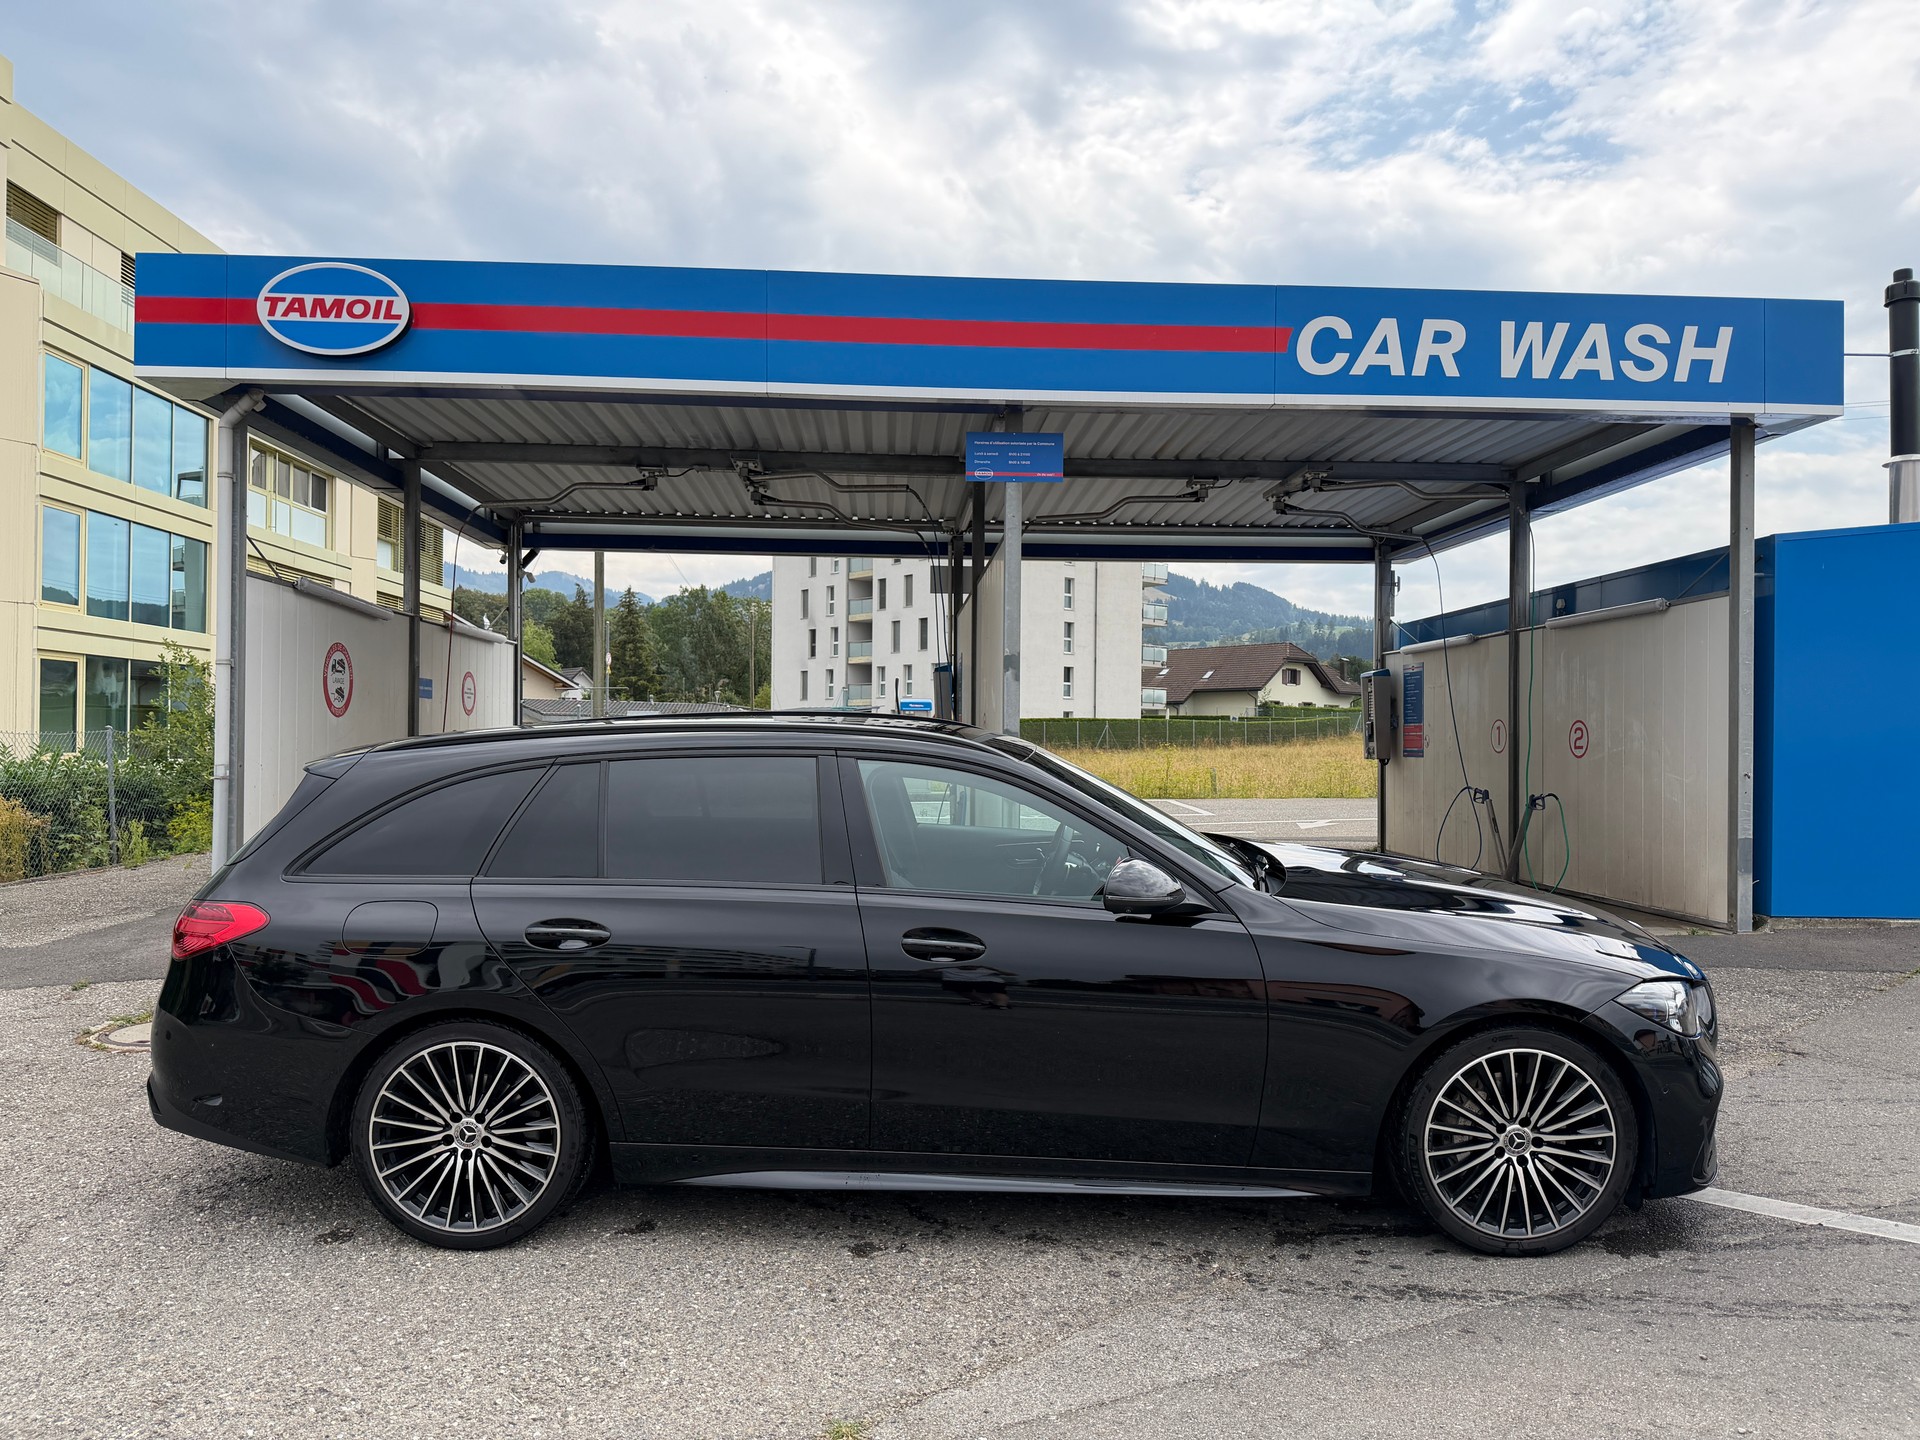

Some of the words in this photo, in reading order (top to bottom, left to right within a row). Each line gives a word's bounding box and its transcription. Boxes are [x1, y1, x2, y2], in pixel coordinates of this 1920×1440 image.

[264, 296, 402, 320] TAMOIL
[1296, 315, 1466, 378] CAR
[1500, 320, 1733, 383] WASH
[1496, 725, 1501, 746] 1
[1574, 727, 1584, 750] 2
